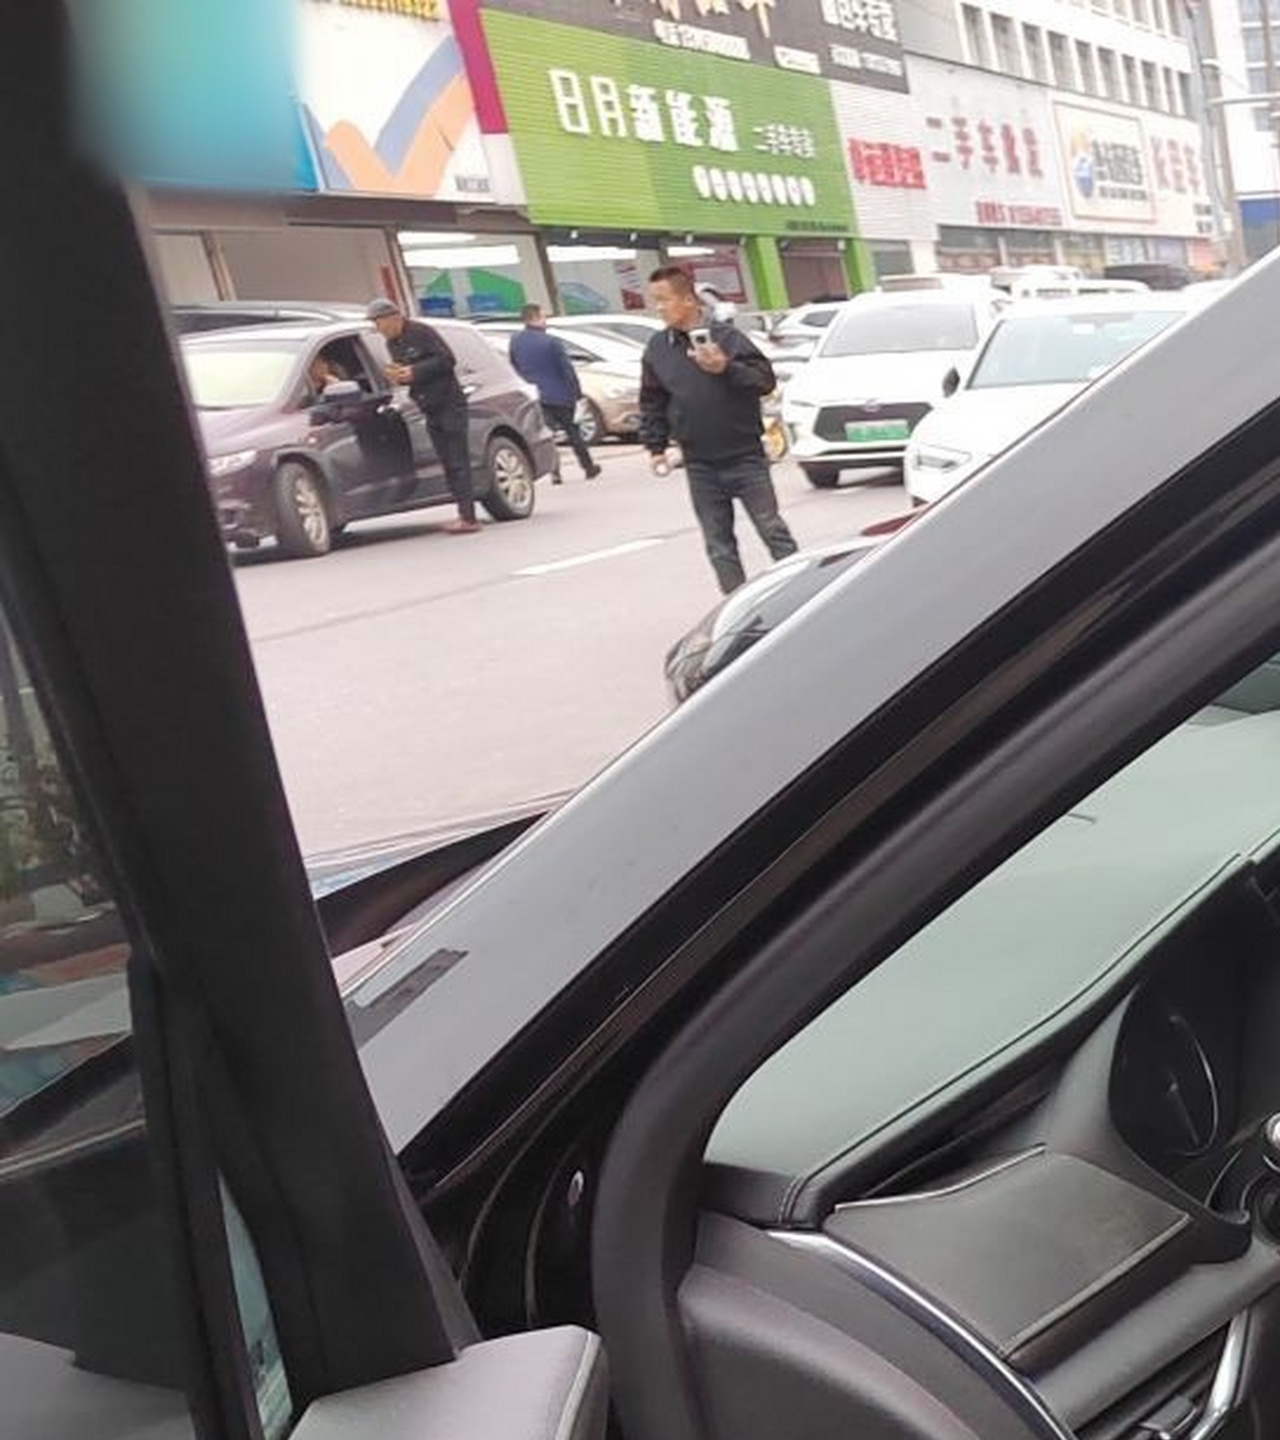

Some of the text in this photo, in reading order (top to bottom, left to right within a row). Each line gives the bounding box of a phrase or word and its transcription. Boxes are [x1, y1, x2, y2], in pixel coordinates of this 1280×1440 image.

[548, 69, 739, 152] 日月新能源
